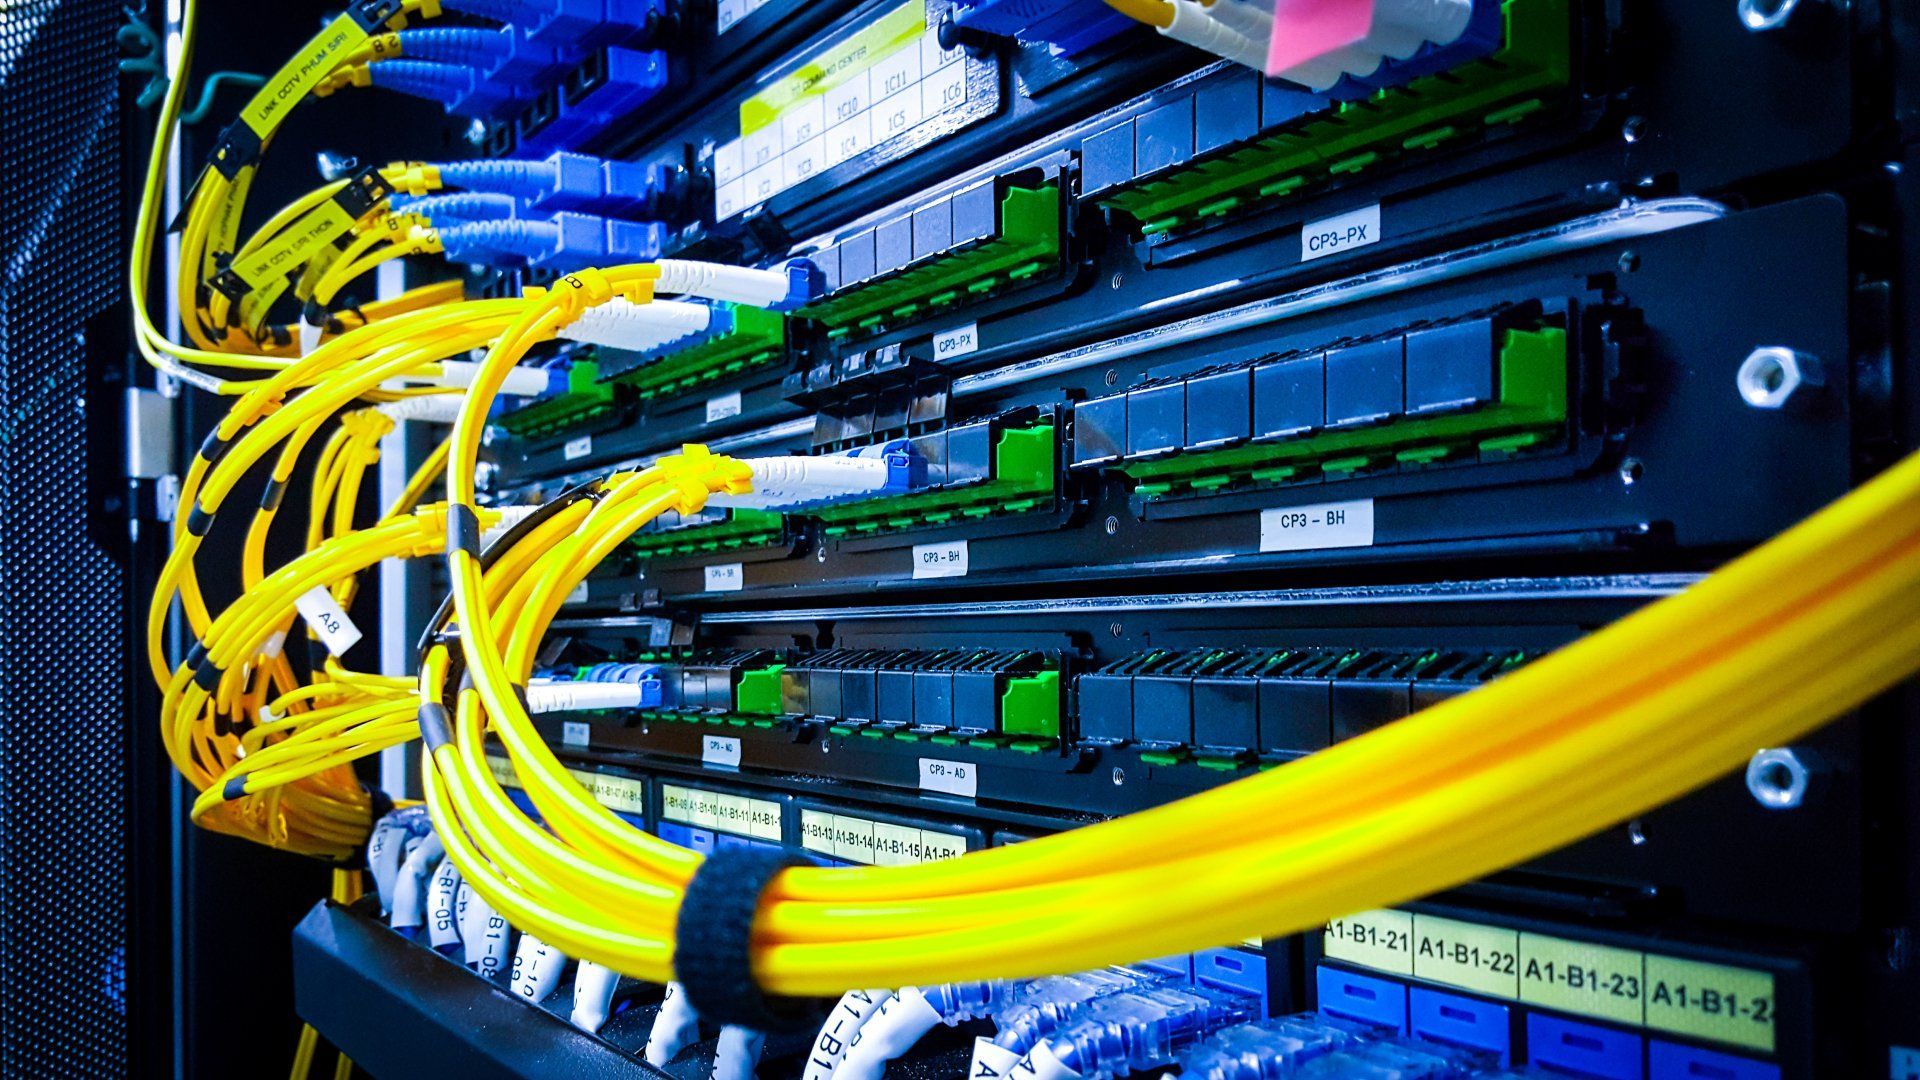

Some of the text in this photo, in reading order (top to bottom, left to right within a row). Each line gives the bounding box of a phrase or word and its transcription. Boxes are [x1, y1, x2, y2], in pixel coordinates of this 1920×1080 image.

[259, 97, 279, 121] LINK
[278, 74, 301, 100] CCTV
[300, 49, 328, 76] PHUM
[837, 96, 858, 120] 1C10
[885, 70, 907, 94] 1C11
[889, 110, 906, 131] 1C5
[943, 81, 962, 104] 1C6
[1309, 224, 1367, 252] CP3-PX
[939, 333, 971, 353] CP3-PX
[1281, 513, 1307, 529] CP3
[1326, 510, 1346, 525] BH
[923, 551, 939, 563] CP3
[948, 550, 960, 562] BH
[318, 612, 341, 634] A8
[929, 763, 945, 776] CP3
[954, 767, 966, 779] AD
[689, 800, 717, 816] A1-B1-10
[719, 806, 749, 822] A1-B1-11
[752, 811, 781, 827] A1-B1-1
[802, 822, 833, 841] A1-B1-13
[835, 830, 873, 849] A1-B1-14
[876, 837, 921, 858] A1-B1-15
[1324, 920, 1774, 1023] A1-B1-21 A1-B1-22 A1-B1-23 A1-B1-2
